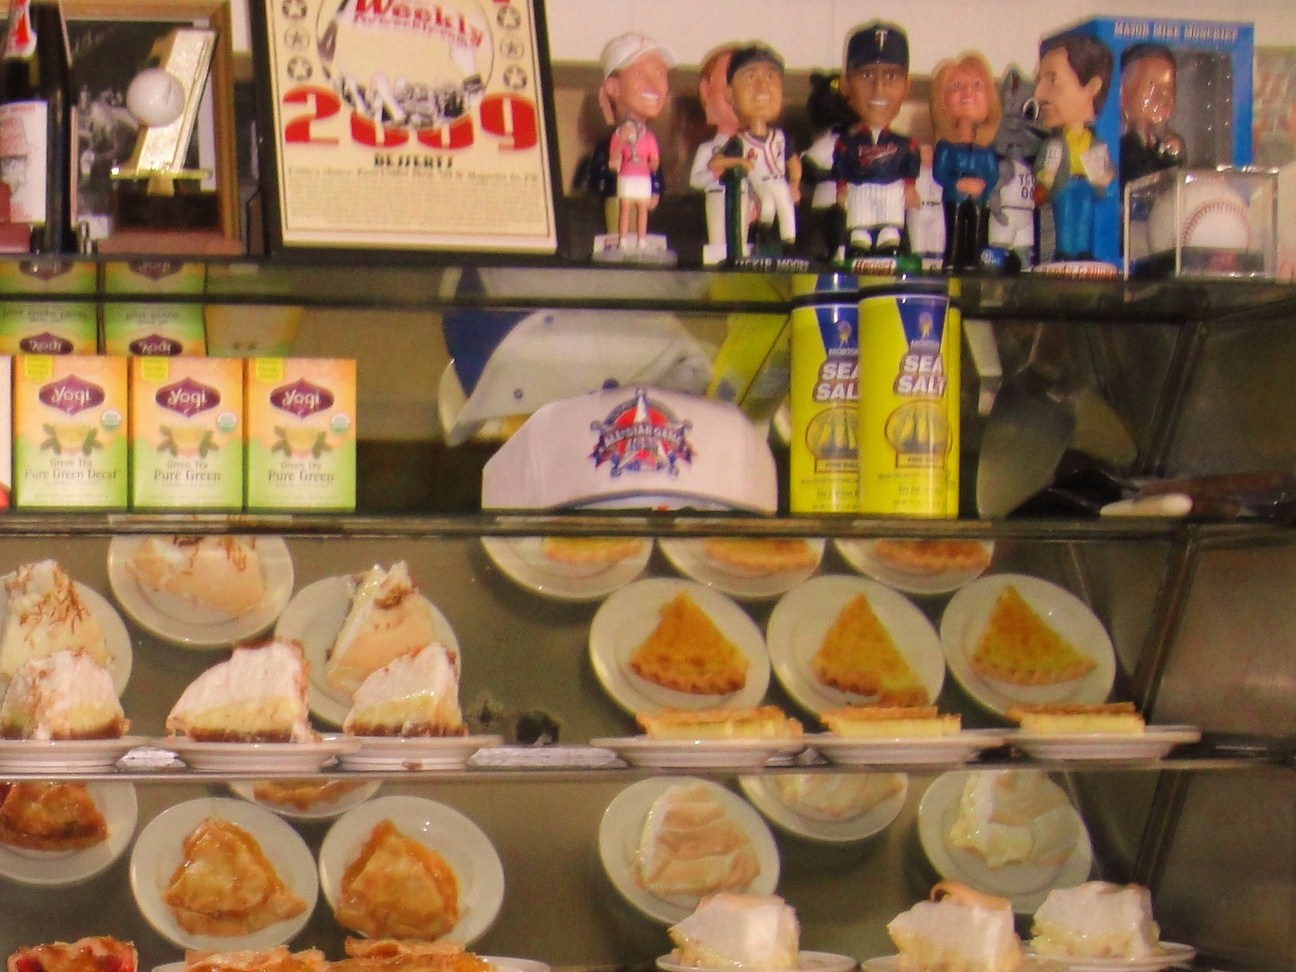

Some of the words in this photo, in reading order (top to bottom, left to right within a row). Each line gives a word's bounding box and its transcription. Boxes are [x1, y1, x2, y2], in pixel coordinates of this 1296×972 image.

[903, 355, 943, 373] SEA
[816, 383, 859, 401] SAL
[896, 375, 946, 395] SALT
[51, 386, 91, 405] Yogi
[167, 388, 208, 407] Yogi
[281, 389, 321, 409] Yogi
[24, 468, 50, 479] Pure
[53, 468, 84, 479] Green
[88, 468, 117, 479] Decaf
[154, 469, 181, 481] Pure
[185, 469, 221, 481] Green
[268, 469, 296, 481] Pure
[299, 469, 335, 481] Green
